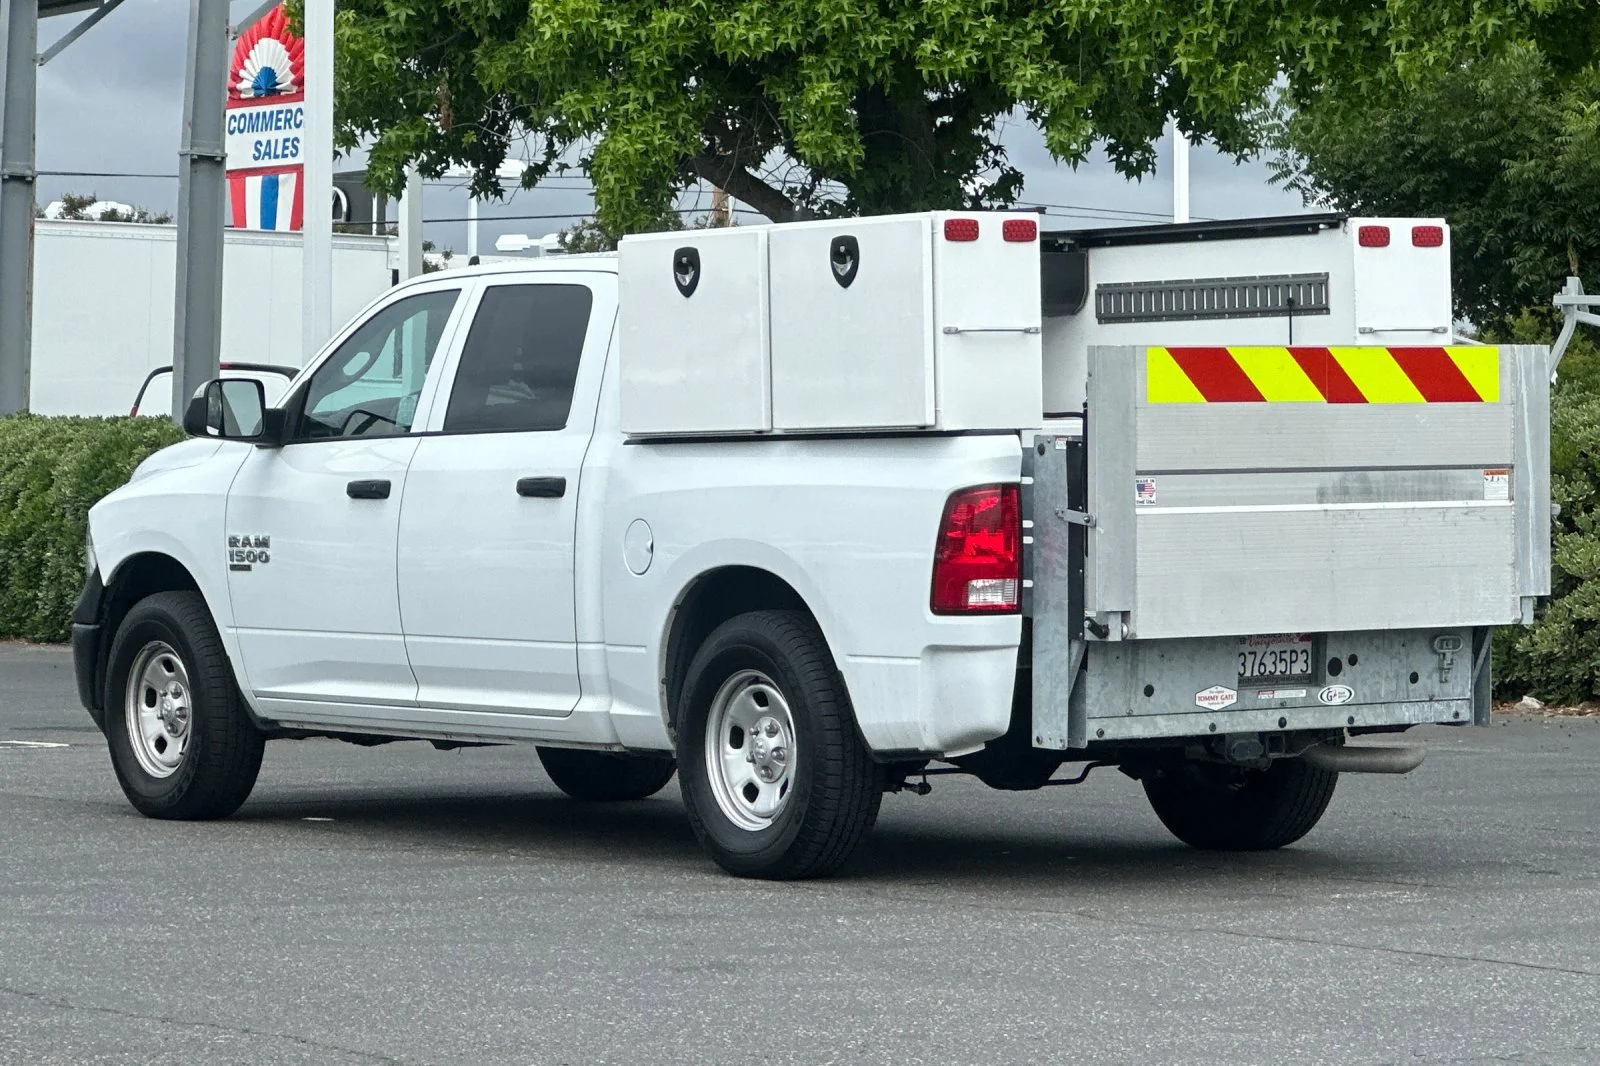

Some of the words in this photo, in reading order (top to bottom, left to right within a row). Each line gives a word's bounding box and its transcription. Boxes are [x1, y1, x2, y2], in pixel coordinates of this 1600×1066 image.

[252, 136, 300, 161] SALES
[229, 535, 271, 548] RAM
[228, 549, 271, 564] 1500
[1237, 648, 1309, 678] 37635P3
